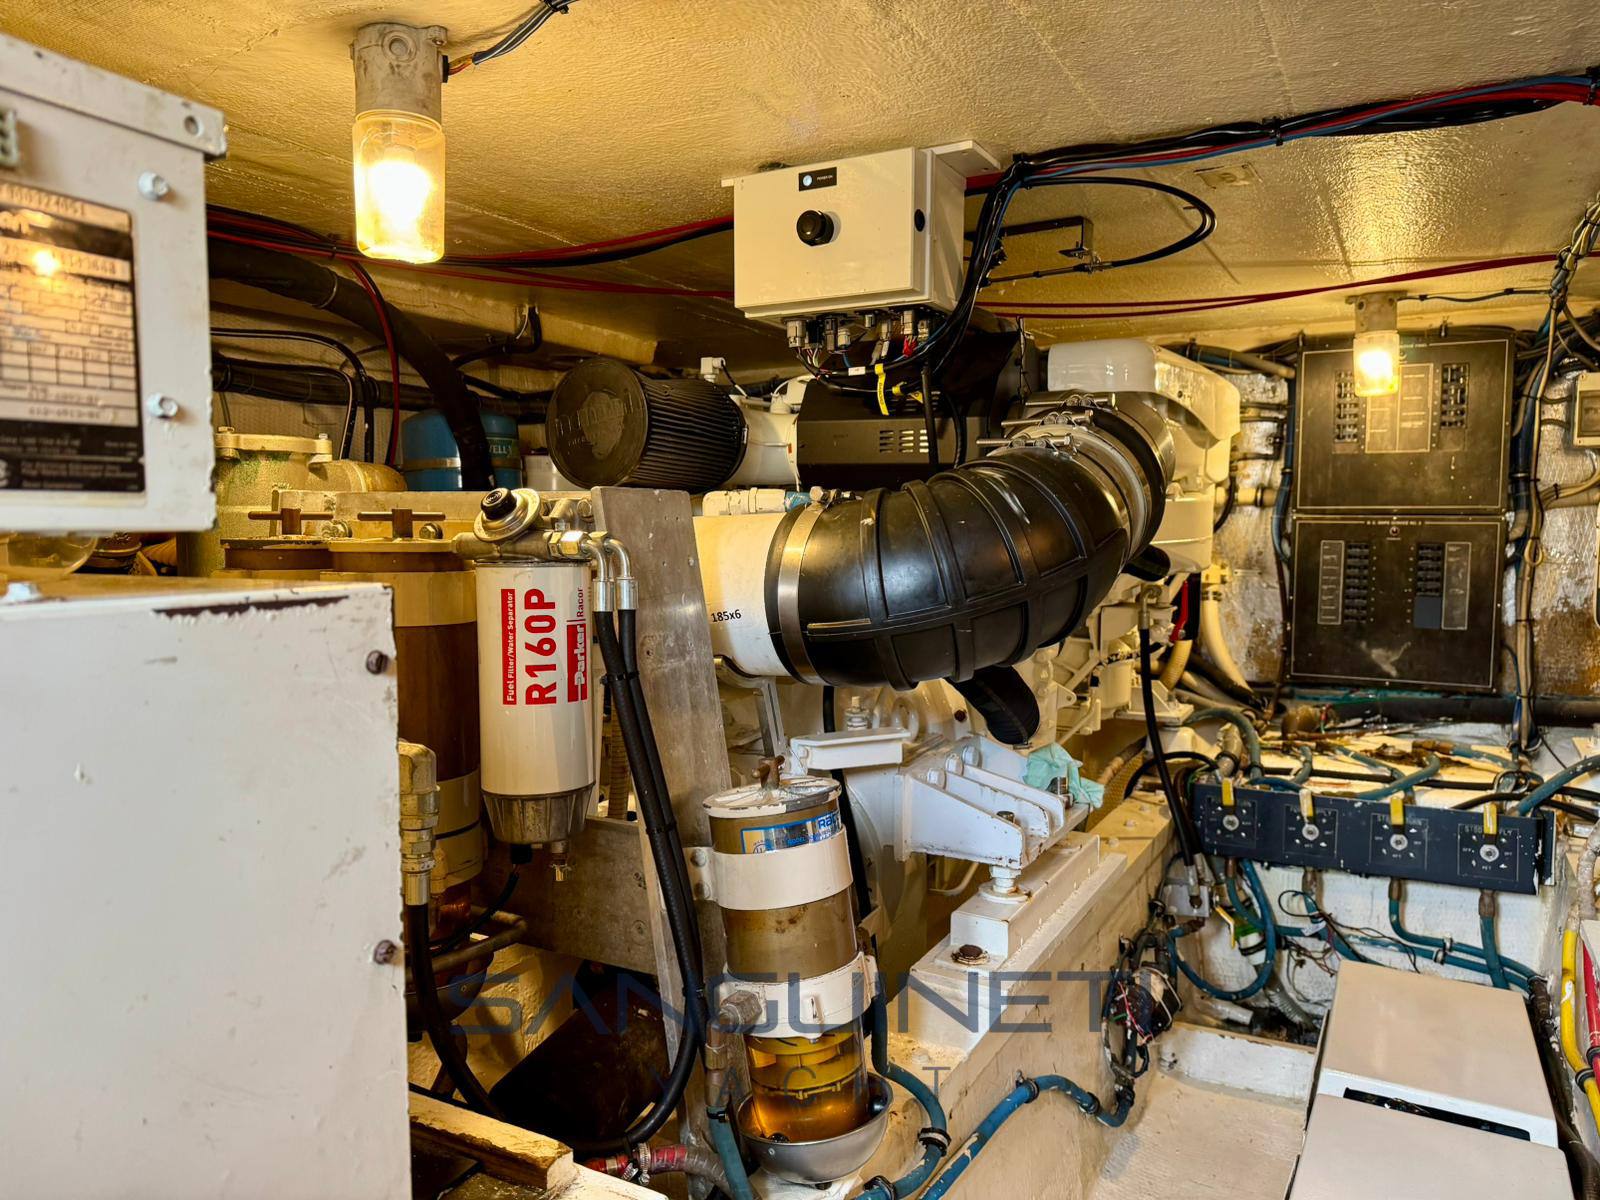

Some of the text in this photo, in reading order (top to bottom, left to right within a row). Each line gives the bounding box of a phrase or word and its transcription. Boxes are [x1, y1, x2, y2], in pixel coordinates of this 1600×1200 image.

[576, 588, 584, 618] Racor
[711, 609, 742, 622] 185x6
[507, 591, 515, 702] Fuel Filter/Water Separator
[524, 588, 557, 705] R160P
[573, 624, 585, 700] Parker
